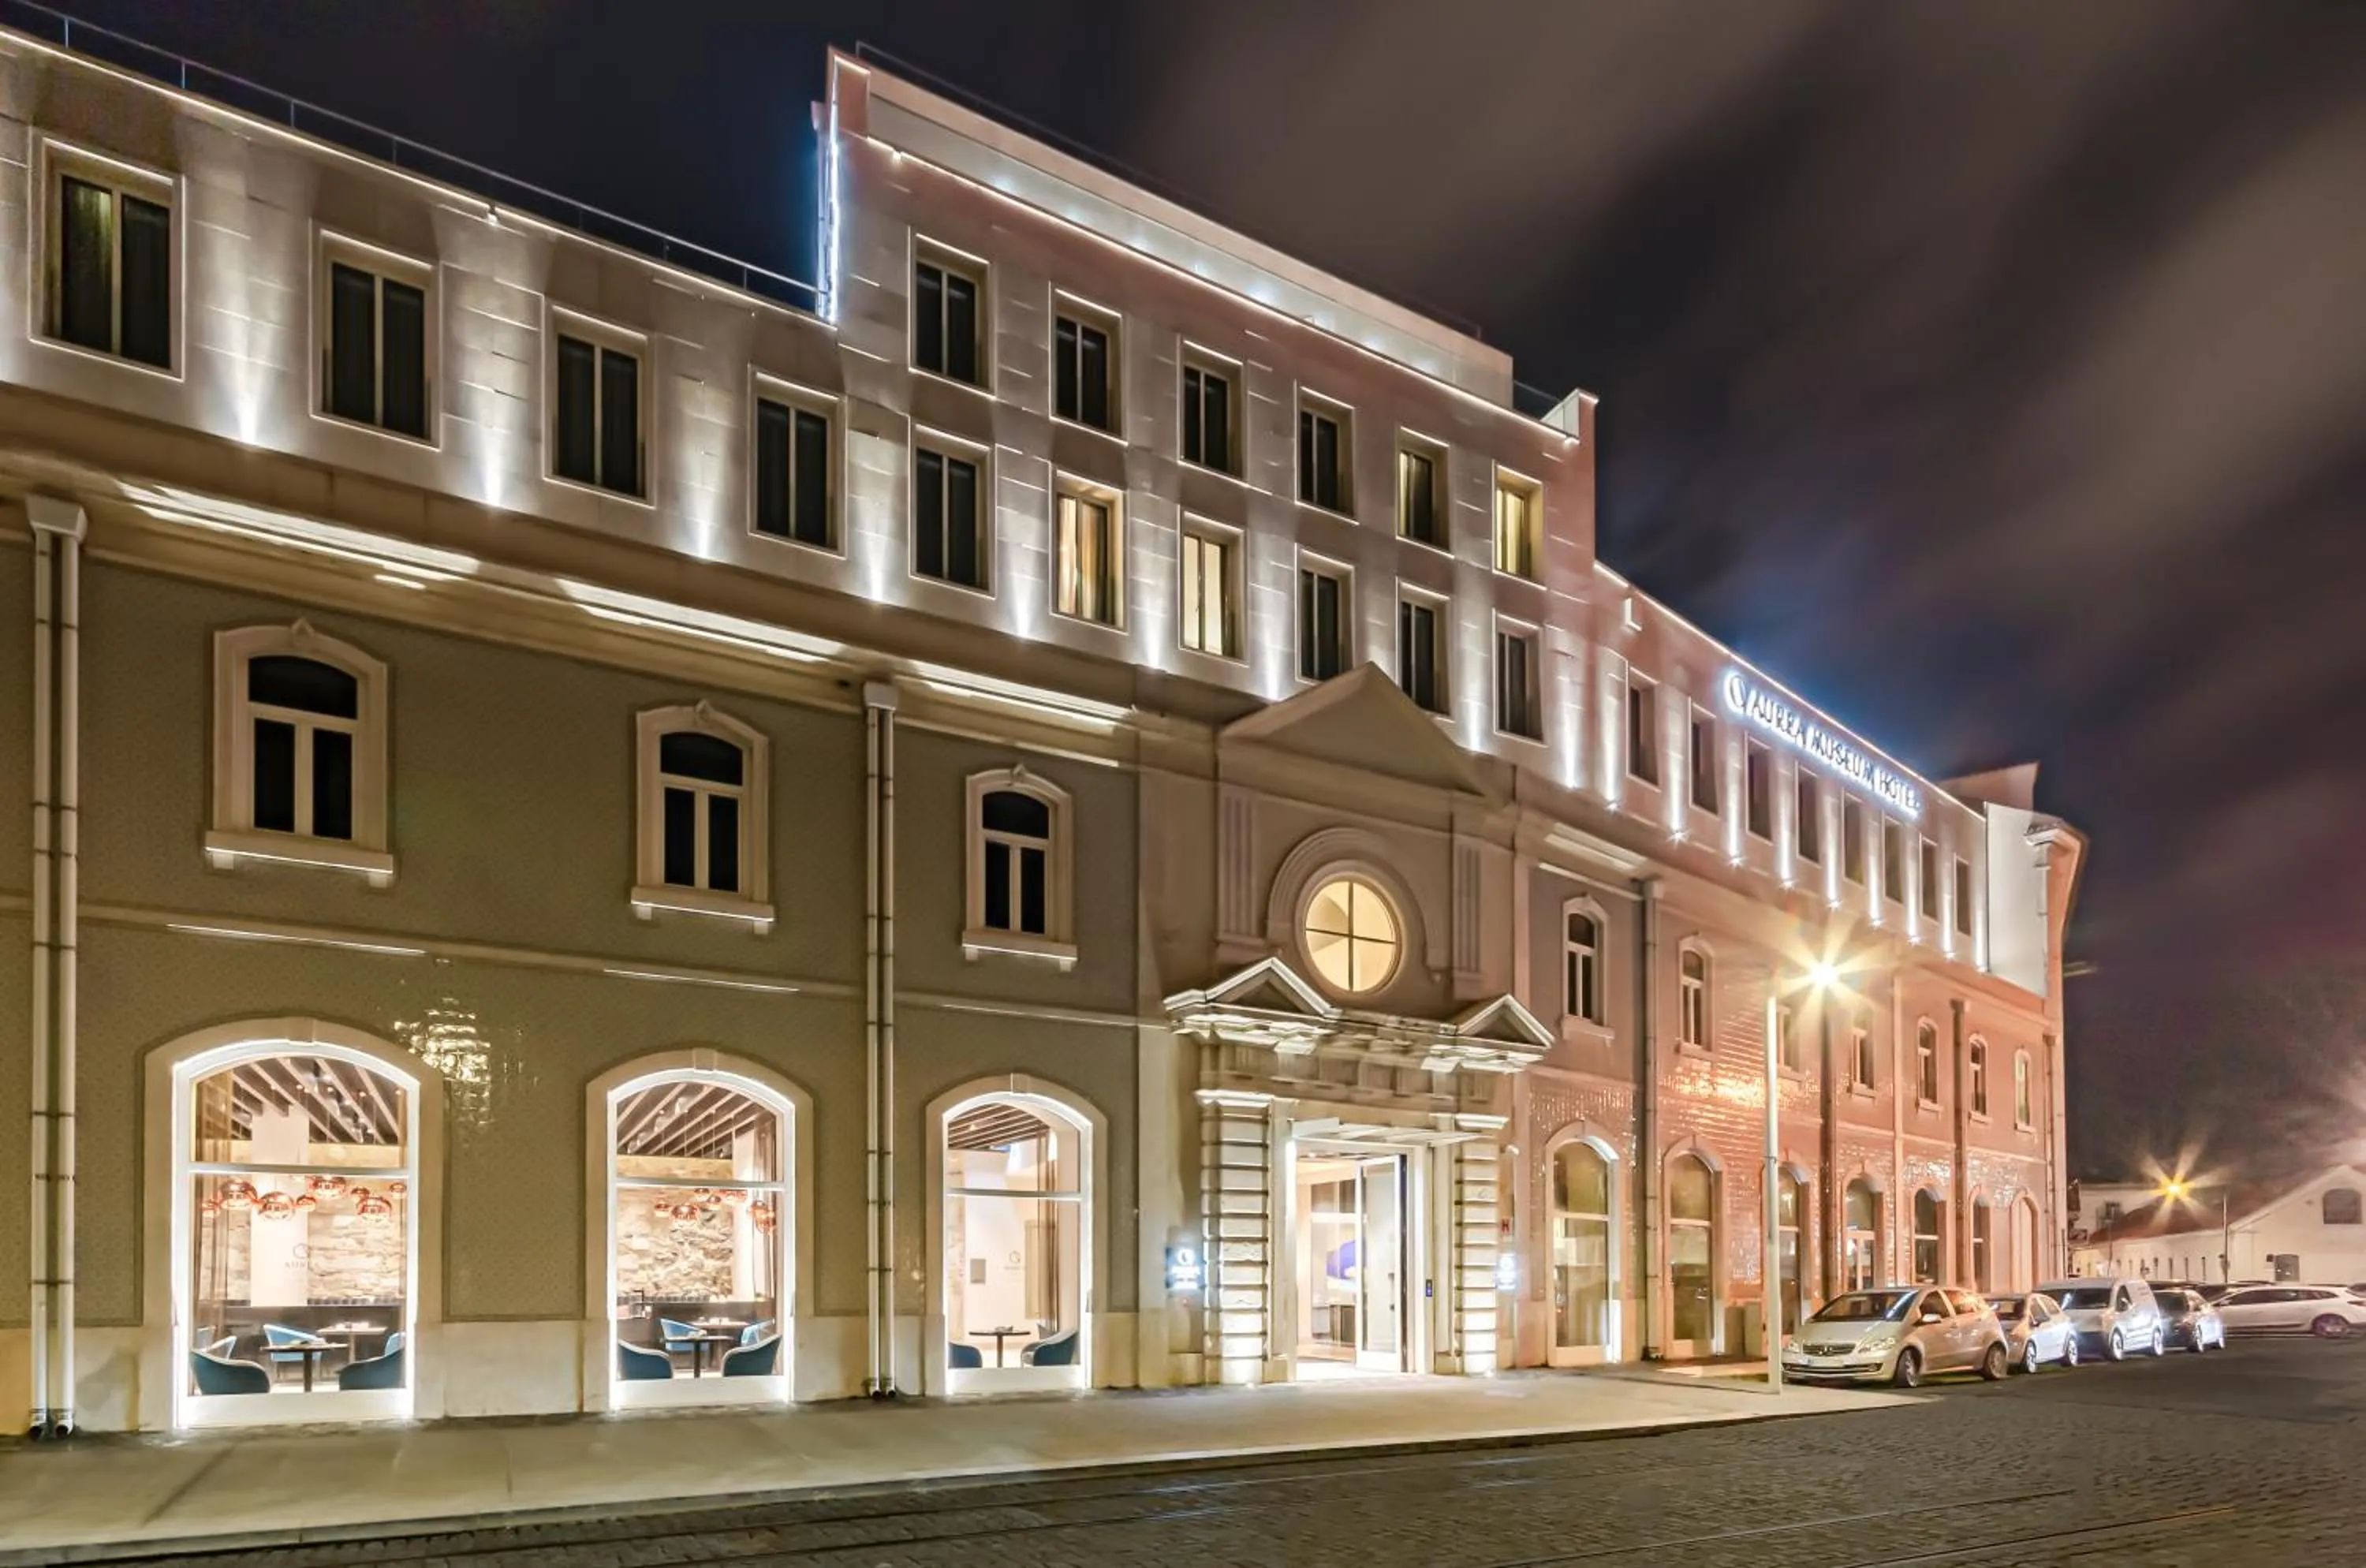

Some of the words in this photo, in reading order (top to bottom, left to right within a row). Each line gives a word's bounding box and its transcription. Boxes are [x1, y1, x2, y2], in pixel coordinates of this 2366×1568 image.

[1751, 691, 1806, 747] AUREA
[1812, 729, 1875, 791] MUSEUM
[1879, 770, 1920, 809] HOTEL
